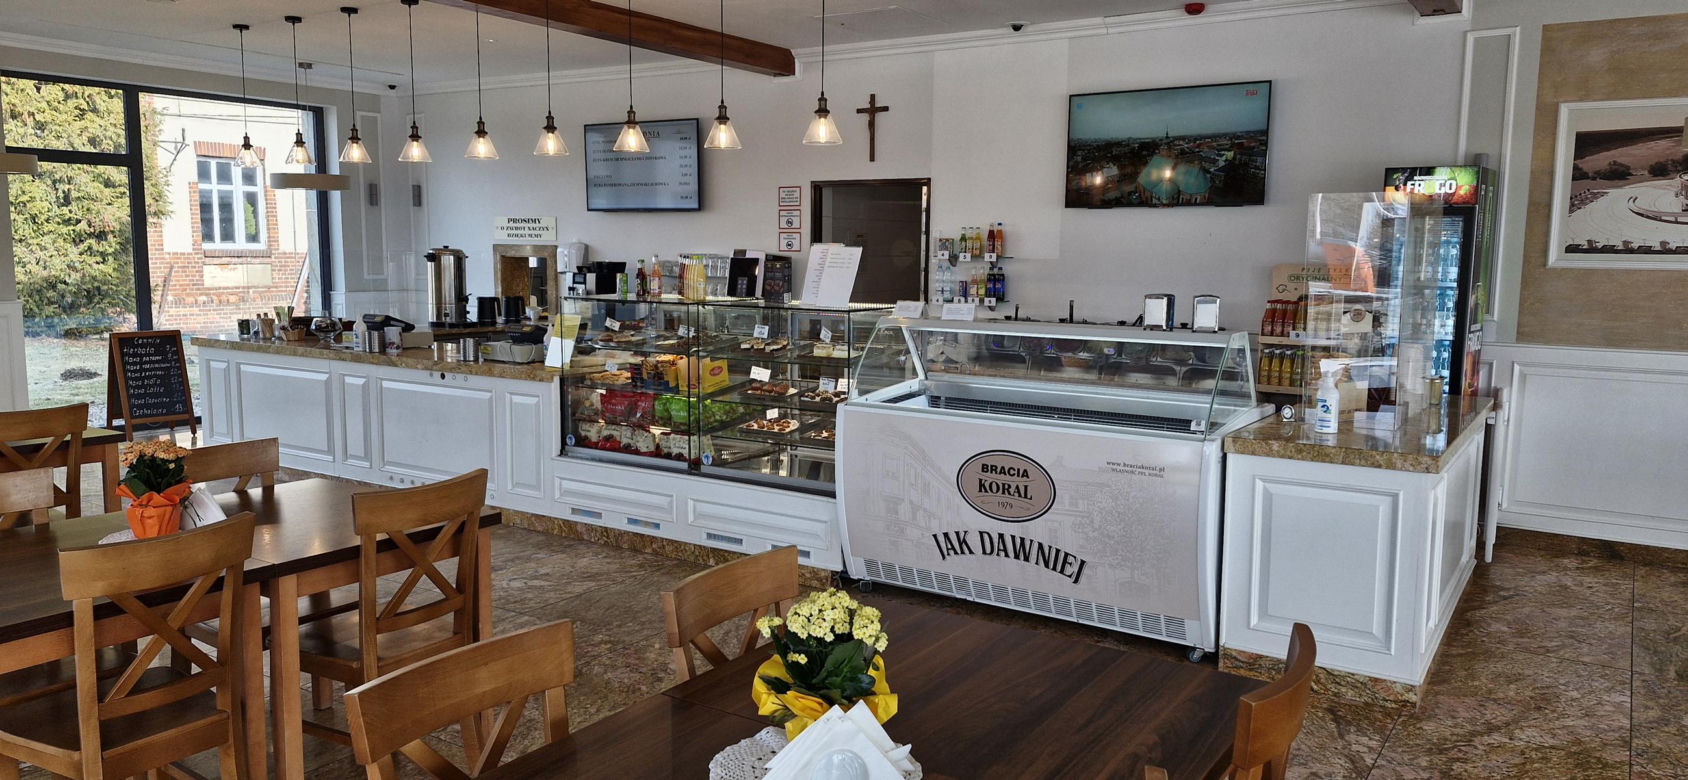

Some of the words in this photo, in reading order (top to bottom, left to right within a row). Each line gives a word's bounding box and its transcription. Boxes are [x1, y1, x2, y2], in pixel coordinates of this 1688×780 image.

[1406, 180, 1457, 195] FRUGO
[123, 345, 155, 354] Herbata
[981, 463, 1030, 479] BRACIA
[1106, 461, 1166, 473] www.braciakoral.pl
[977, 478, 1033, 501] KORAL
[997, 501, 1013, 510] 1979
[931, 530, 975, 561] JAK
[978, 530, 1087, 584] DAWNIEJ
